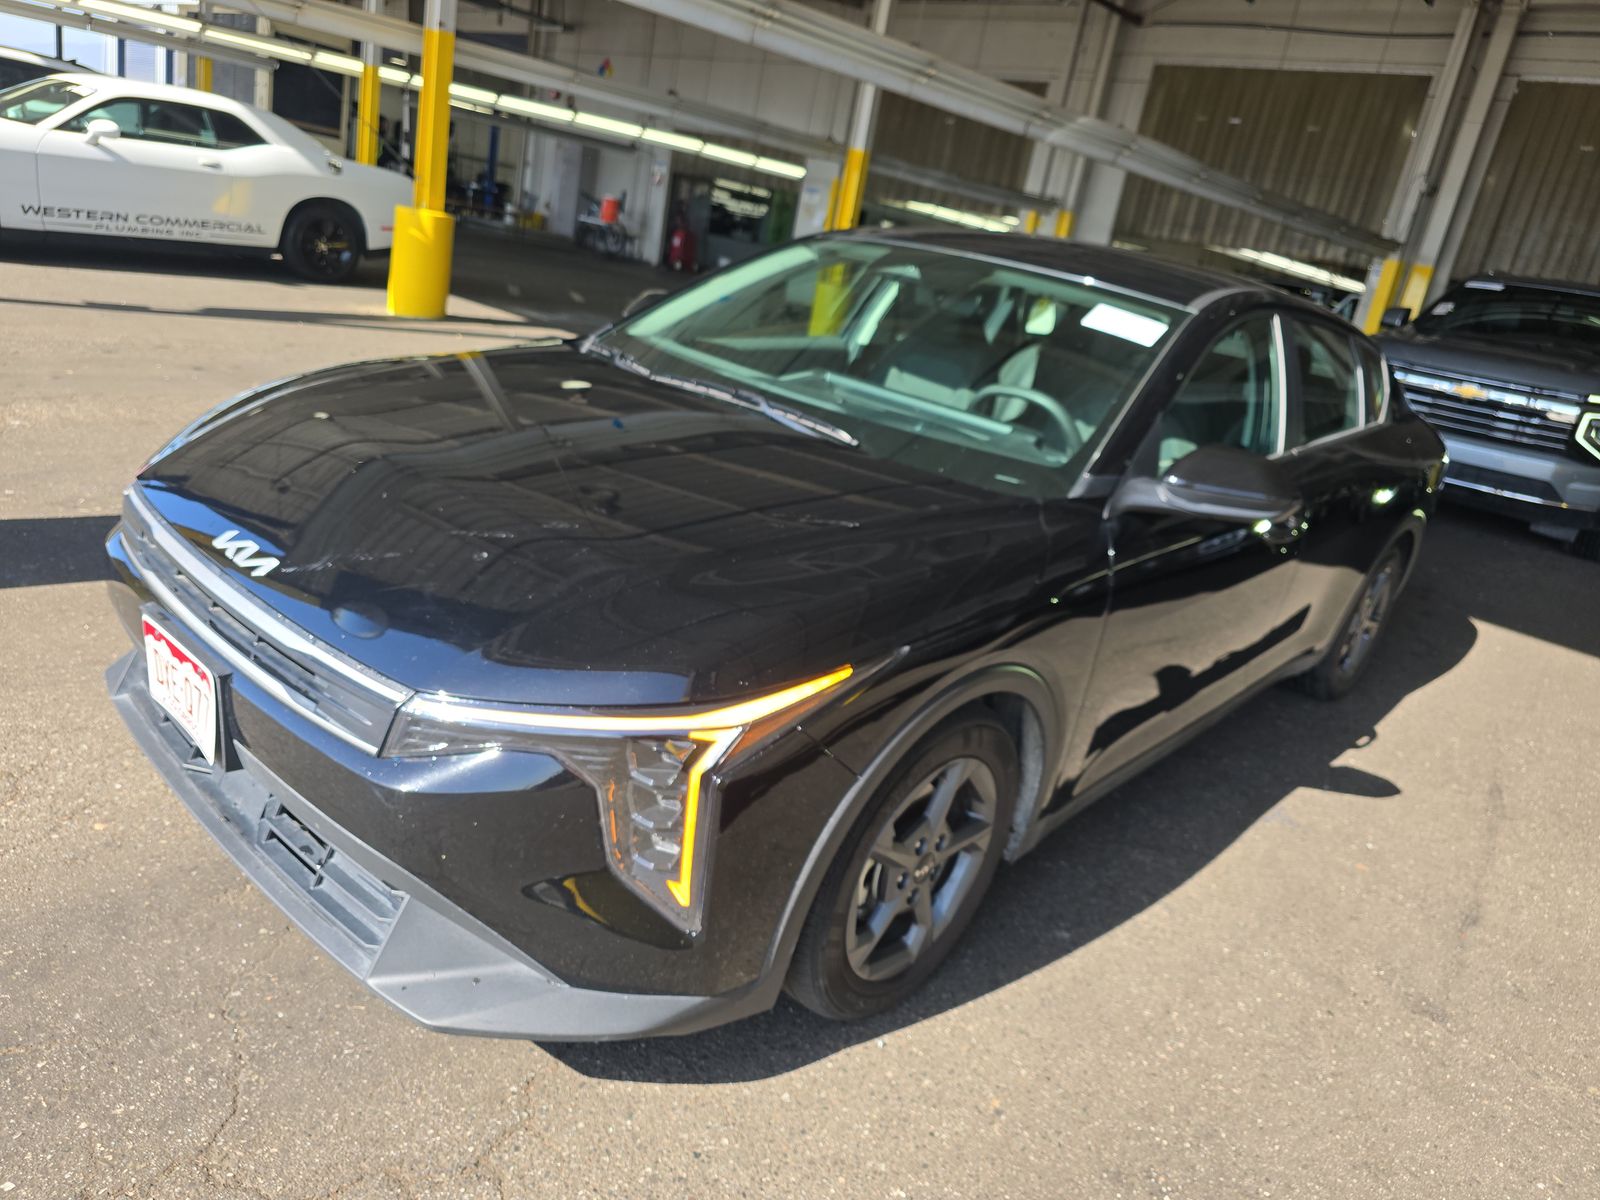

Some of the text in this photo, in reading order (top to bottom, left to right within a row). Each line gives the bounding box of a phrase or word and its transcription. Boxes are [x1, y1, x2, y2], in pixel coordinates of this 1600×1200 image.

[21, 204, 266, 235] WESTERN COMMERCIAL
[93, 223, 174, 237] PLUMBING
[211, 529, 281, 578] KIA
